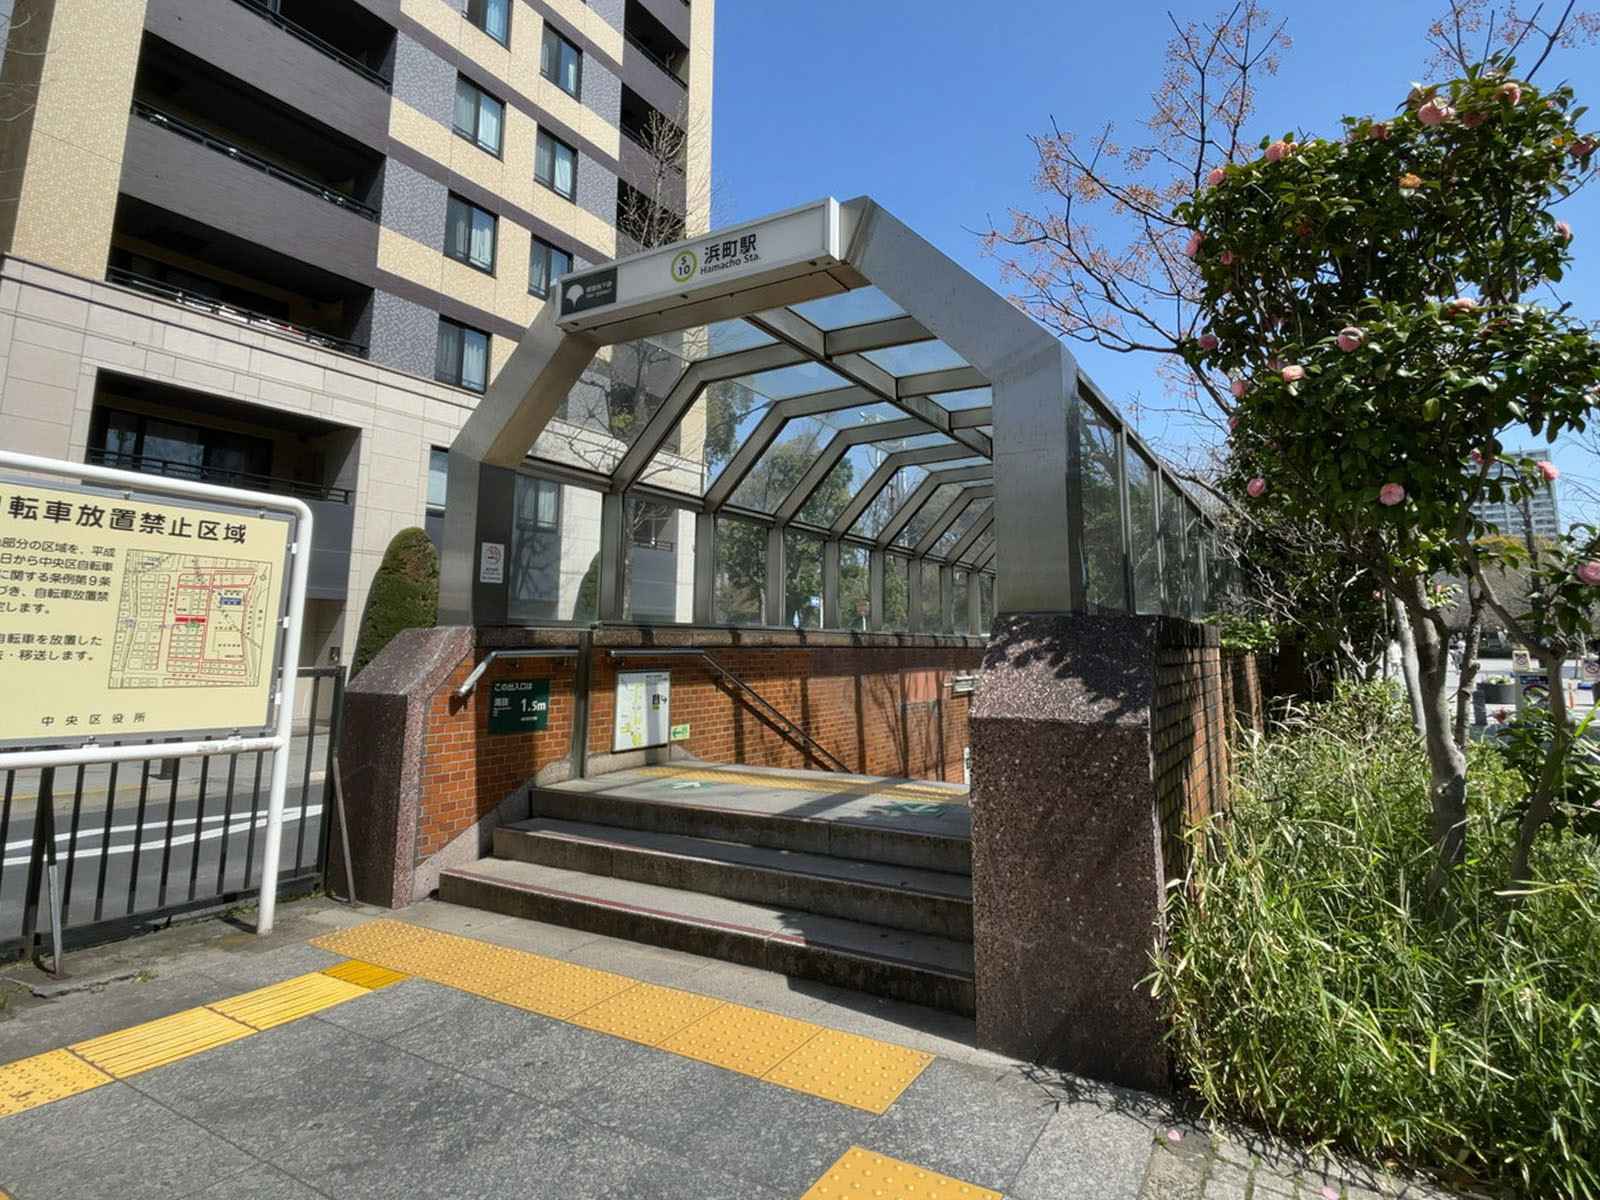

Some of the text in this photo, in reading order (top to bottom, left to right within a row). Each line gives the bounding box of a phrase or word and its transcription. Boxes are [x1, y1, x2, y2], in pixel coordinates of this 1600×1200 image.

[704, 233, 757, 264] 浜町駅
[681, 256, 687, 265] S
[700, 253, 762, 275] Hamacho Sta.
[678, 264, 691, 276] 10
[0, 495, 247, 544] 転車放置禁止区域
[0, 537, 116, 557] 部分の区域を、平成
[0, 553, 113, 571] 日から中央区自転車
[0, 649, 94, 661] ・移送します。
[520, 698, 547, 712] 1.5m
[41, 712, 146, 727] 中央区役所
